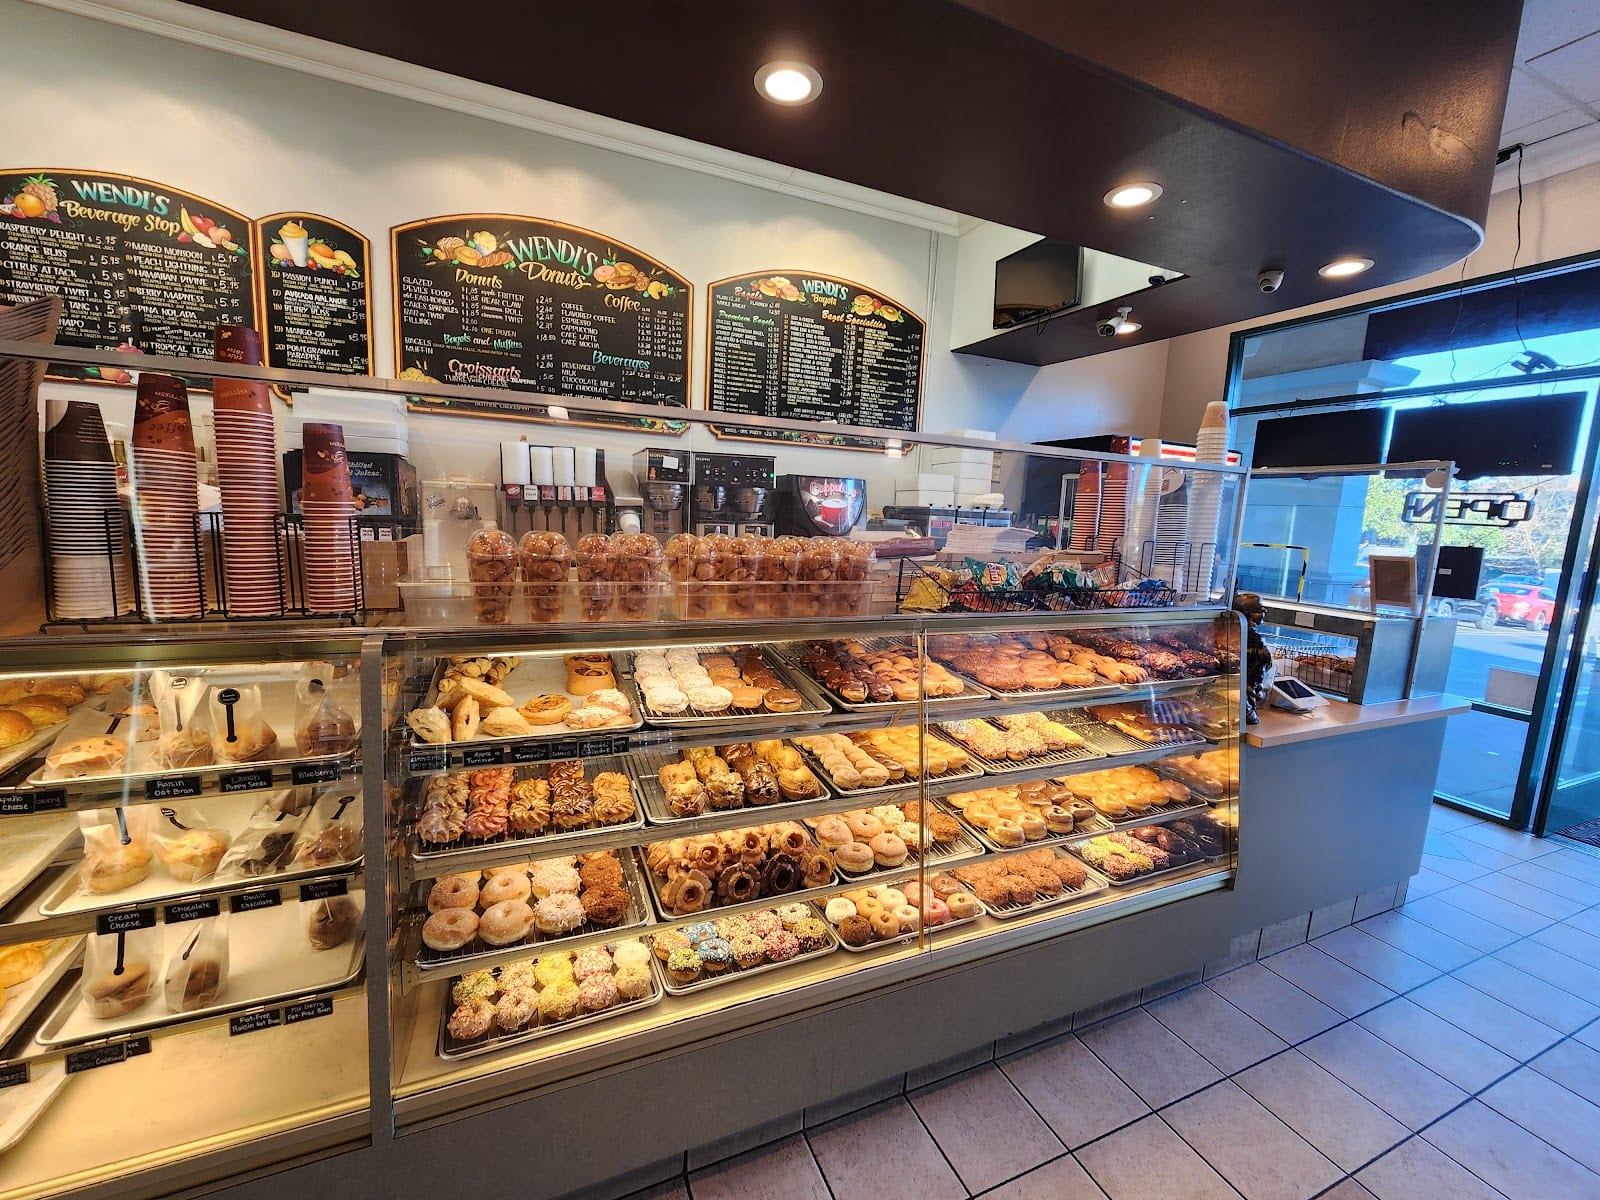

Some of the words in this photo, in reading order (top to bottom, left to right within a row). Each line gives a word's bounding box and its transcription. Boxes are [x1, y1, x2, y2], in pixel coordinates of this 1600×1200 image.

[71, 180, 170, 216] WENDI'S
[59, 200, 140, 232] Beverage
[144, 213, 180, 236] Stop
[0, 221, 46, 236] RASPBERRY
[49, 229, 85, 242] DELIGHT
[1, 241, 40, 253] ORANGE
[43, 246, 68, 258] BLISS
[132, 242, 162, 254] MANGO
[164, 246, 203, 260] MONSOON
[507, 236, 599, 276] WENDI'S
[3, 260, 38, 272] CITRUS
[41, 265, 77, 278] ATTACK
[133, 255, 161, 267] PEACH
[165, 260, 208, 274] LIGHTNING
[134, 268, 177, 283] HAWAIIAN
[181, 276, 208, 287] DIVINE
[282, 272, 311, 282] PASSION
[314, 276, 338, 287] PUNCH
[403, 276, 433, 287] GLAZED
[456, 268, 503, 290] Donuts
[518, 262, 592, 290] Donuts
[6, 280, 60, 294] STRAWBERRY
[63, 286, 90, 297] TWIST
[136, 286, 161, 298] BERRY
[164, 291, 205, 304] MADNESS
[735, 286, 763, 300] Bagels
[802, 279, 849, 301] WENDI'S
[430, 288, 451, 298] FOOD
[502, 299, 522, 309] CLAW
[604, 294, 641, 313] Coffee
[69, 302, 90, 312] TANG
[284, 304, 308, 314] BERRY
[310, 307, 330, 317] BLISS
[414, 294, 454, 306] FASHIONED
[504, 307, 524, 317] ROLL
[561, 302, 585, 312] COFFEE
[162, 307, 197, 320] KOLADA
[403, 300, 427, 310] CAKES
[504, 315, 524, 325] TWIST
[403, 307, 419, 317] BAR
[427, 311, 446, 321] TWIST
[561, 309, 592, 321] FLAVORED
[593, 314, 617, 324] COFFEE
[821, 310, 844, 323] Bagel
[403, 315, 433, 327] FILLING
[561, 316, 592, 327] ESPRESSO
[752, 315, 776, 327] Bagels
[184, 330, 206, 339] BLAST
[480, 326, 494, 335] ONE
[560, 324, 598, 335] CAPPUCCINO
[404, 336, 433, 347] BAGELS
[443, 333, 472, 345] Bagels
[579, 334, 598, 342] LATTE
[150, 341, 188, 353] TROPICAL
[286, 344, 340, 357] POMEGRANATE
[405, 345, 434, 355] MUFFIN
[286, 351, 322, 361] PARADISE
[592, 350, 651, 371] Beverages
[448, 358, 522, 380] Croissants
[561, 361, 596, 372] BEVERAGES
[561, 368, 577, 377] MILK
[561, 376, 598, 387] CHOCOLATE
[600, 380, 616, 388] MILK
[575, 385, 609, 395] CHOCOLATE
[231, 774, 260, 784] Lemon
[297, 769, 334, 780] Blueberry
[157, 780, 185, 788] Raisin
[171, 901, 212, 914] Chocolate
[107, 912, 140, 923] Cream
[109, 919, 142, 931] Cheese
